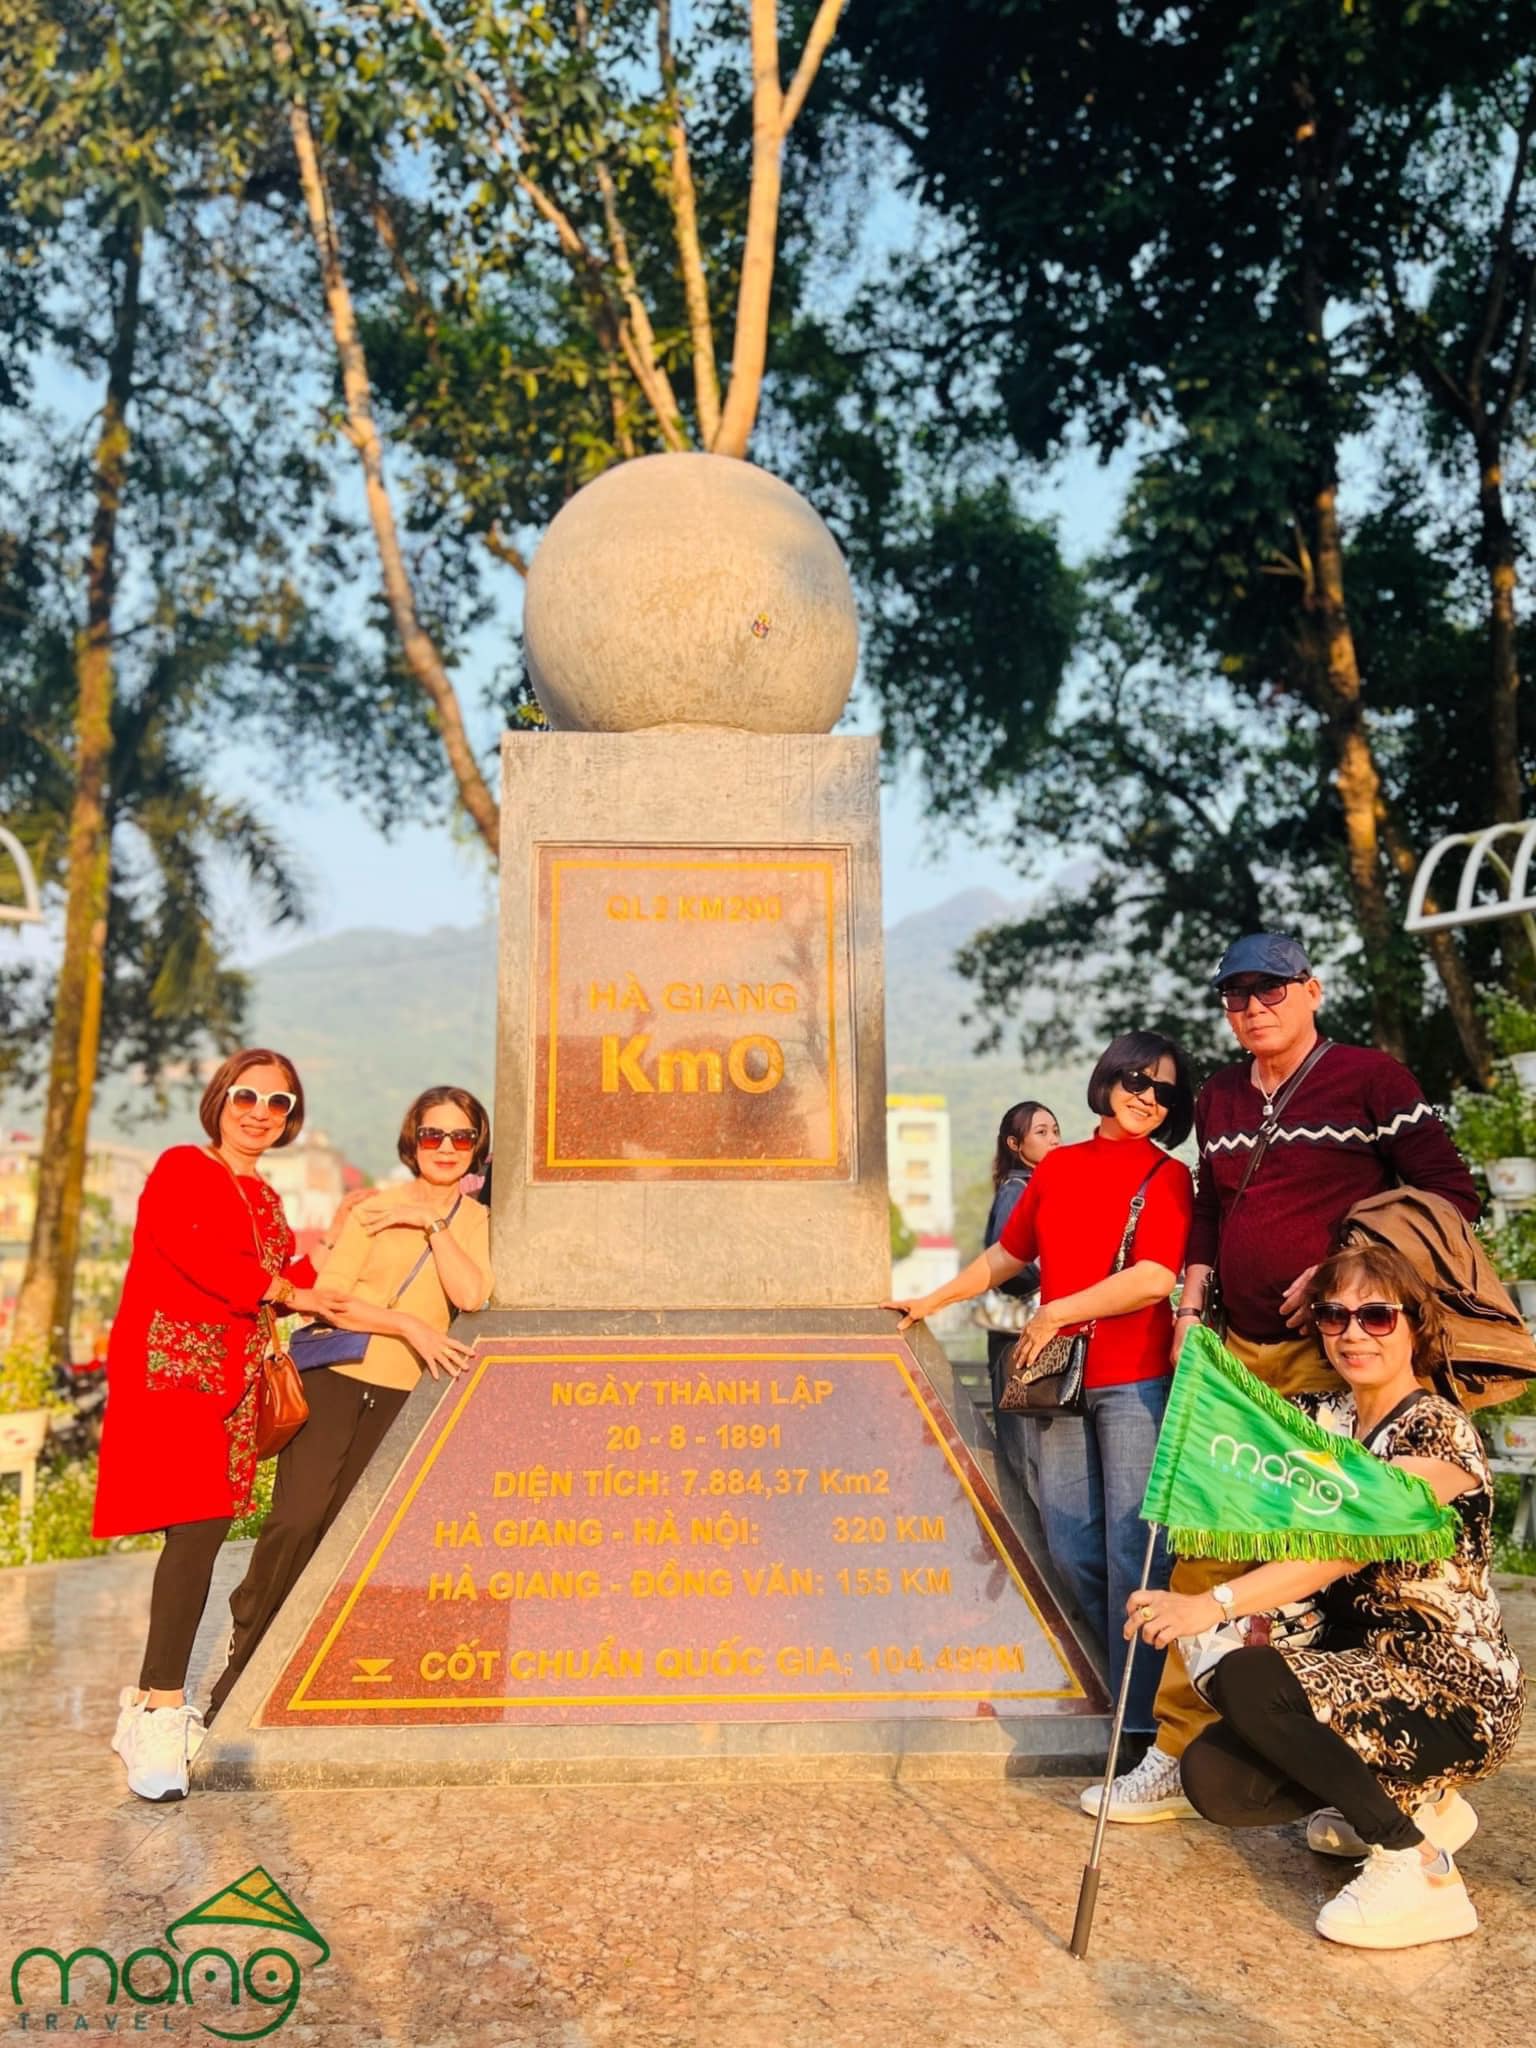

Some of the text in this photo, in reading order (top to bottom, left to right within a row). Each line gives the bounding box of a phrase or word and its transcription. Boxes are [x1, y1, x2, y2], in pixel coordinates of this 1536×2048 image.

[588, 971, 798, 1013] HÀ GIANG
[551, 1373, 834, 1410] NGÀY THÀNH LẬP
[606, 1425, 642, 1450] 20
[668, 1425, 687, 1450] 8
[716, 1424, 782, 1450] 1891
[492, 1464, 891, 1504] DIỆN TÍCH: 7.884,37 Km2
[433, 1512, 484, 1549] HÀ
[492, 1519, 604, 1548] GIANG
[633, 1509, 683, 1546] HÀ
[690, 1510, 761, 1552] NỘI:
[832, 1516, 888, 1544] 320
[896, 1516, 946, 1543] KM
[428, 1564, 478, 1601] HÀ
[487, 1571, 600, 1600] GIANG
[742, 1562, 825, 1596] VĂN:
[836, 1568, 892, 1595] 155
[902, 1568, 953, 1596] KM
[419, 1637, 500, 1682] CỐT
[655, 1635, 767, 1678] QUỐC
